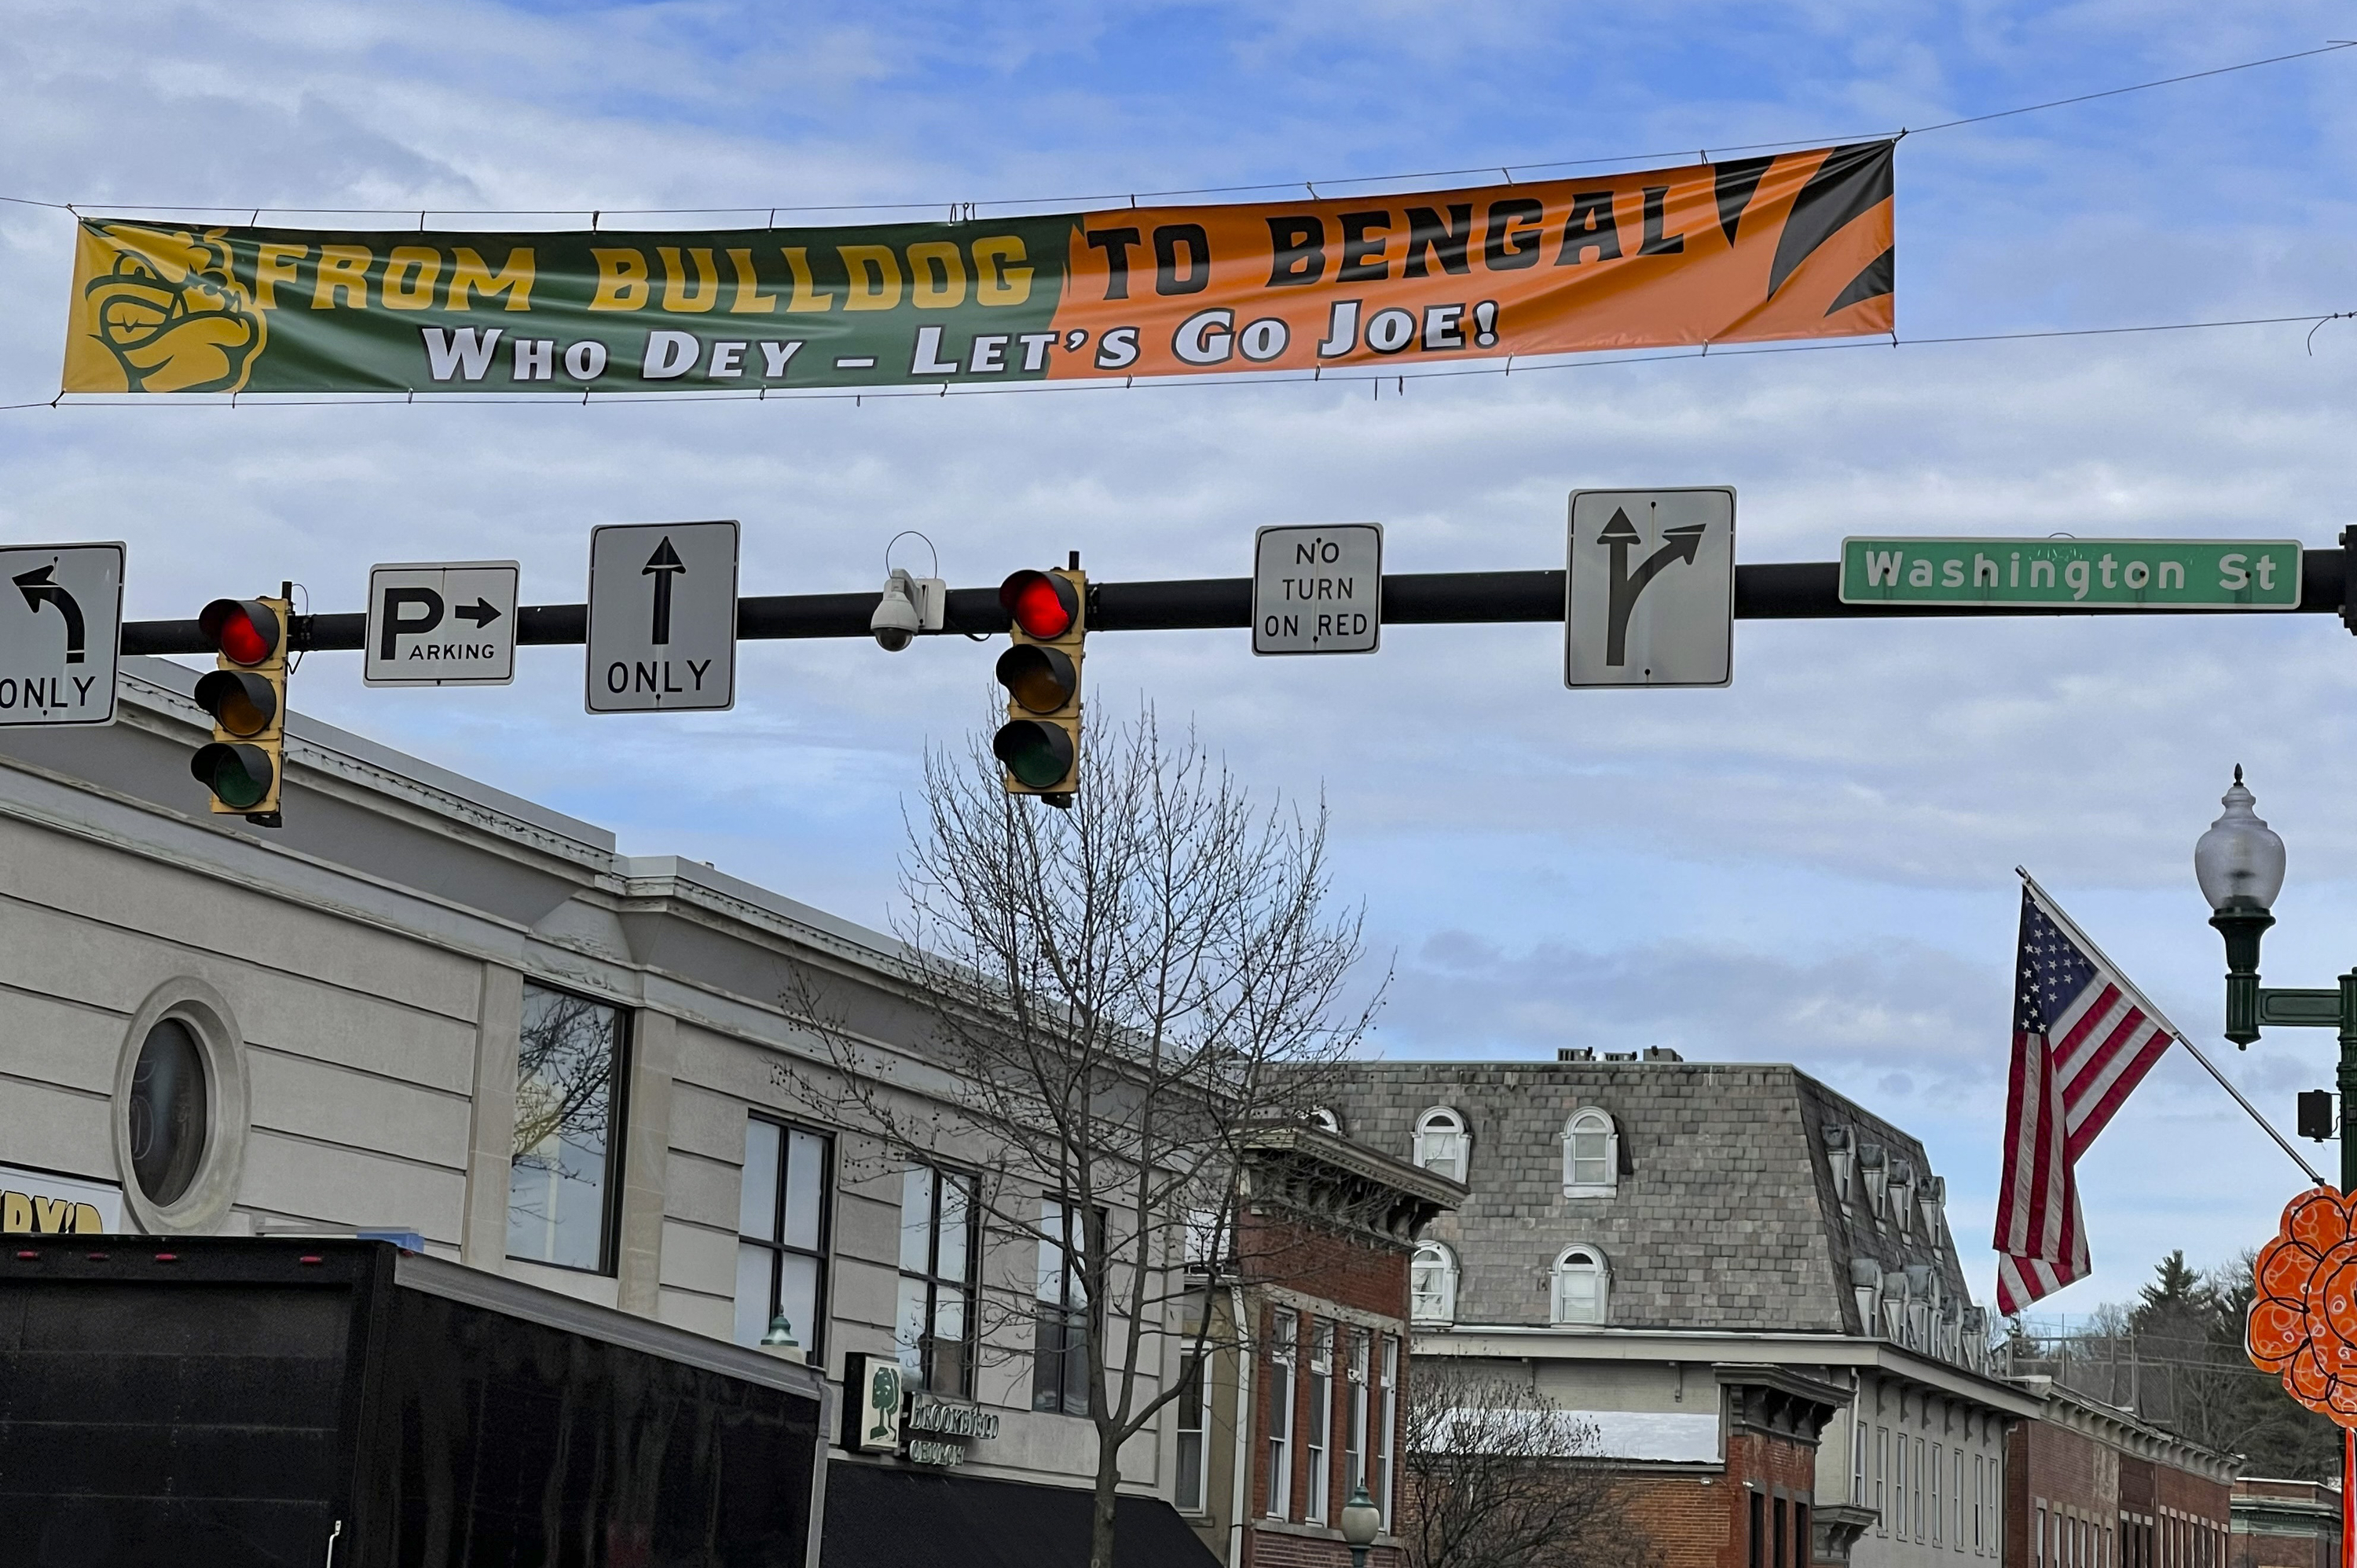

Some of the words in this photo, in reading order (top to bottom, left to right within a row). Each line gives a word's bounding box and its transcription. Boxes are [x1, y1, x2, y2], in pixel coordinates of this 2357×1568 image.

[252, 243, 536, 312] FROM
[588, 236, 1035, 313] BULLDOG
[1087, 223, 1211, 301] TO
[1264, 185, 1684, 288] BENGAL
[420, 327, 608, 382] WHO
[642, 329, 805, 380] DEY
[1171, 307, 1290, 366] GO
[1317, 299, 1500, 358] JOE!
[1295, 542, 1340, 565] NO
[1282, 577, 1354, 601] TURN
[1865, 551, 2185, 601] Washington
[2219, 553, 2277, 591] St
[1264, 615, 1299, 638] ON
[1318, 614, 1368, 637] RED
[0, 676, 96, 709] ONLY
[607, 658, 713, 694] ONLY
